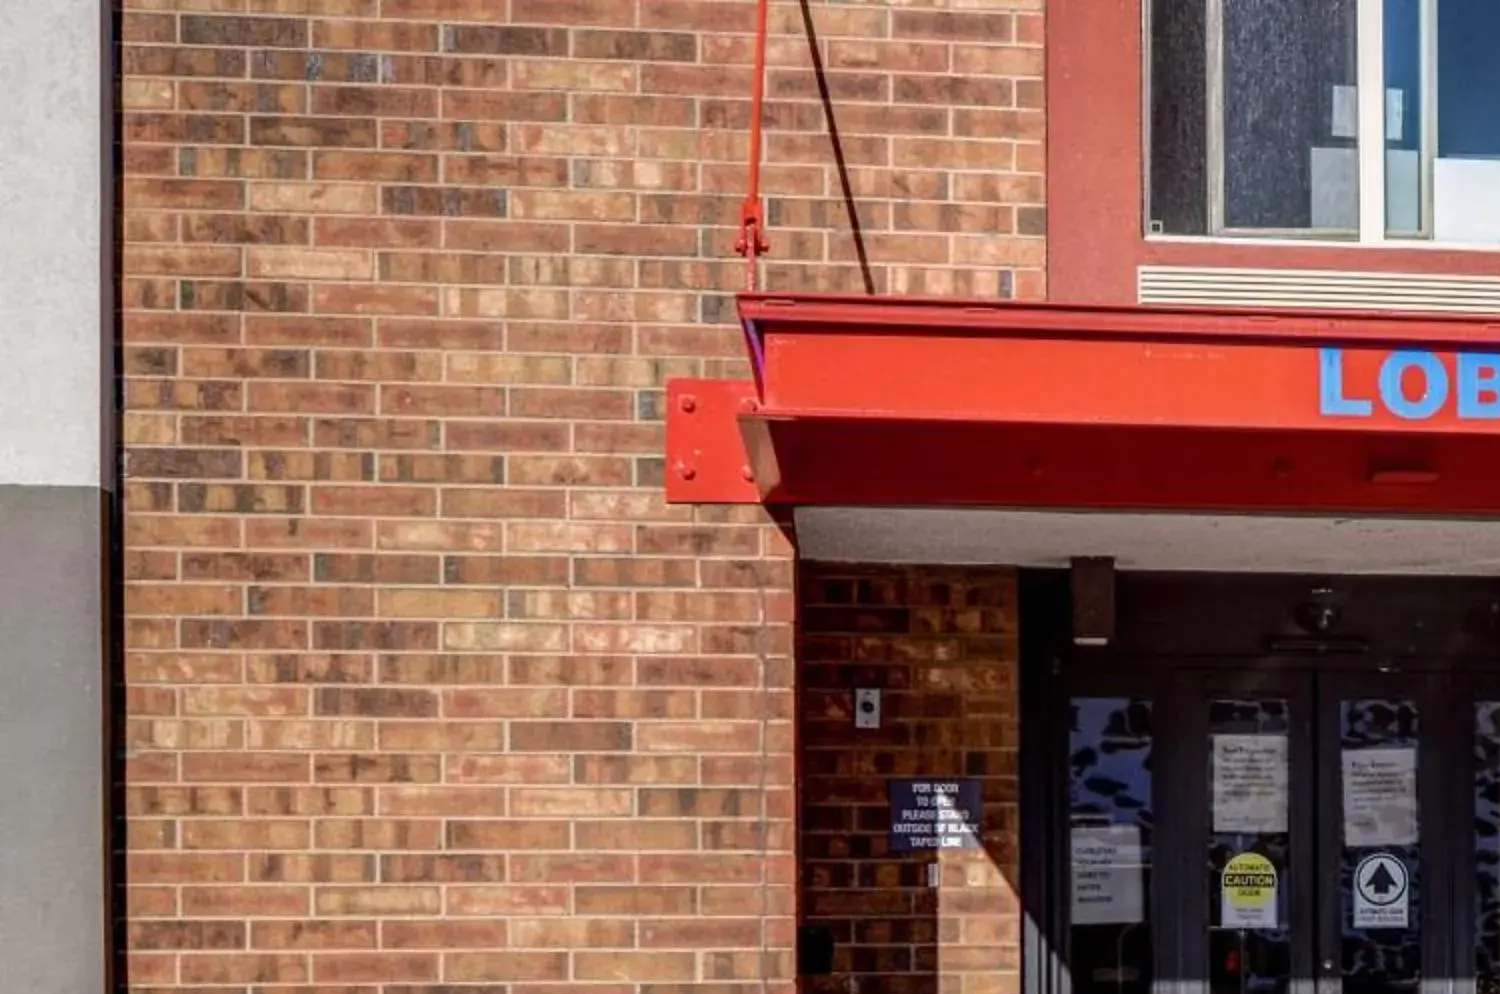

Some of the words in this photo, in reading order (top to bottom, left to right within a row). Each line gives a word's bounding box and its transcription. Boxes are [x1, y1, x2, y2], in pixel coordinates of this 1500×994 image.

[912, 784, 931, 793] FOR
[933, 784, 959, 793] DOOR
[893, 823, 932, 833] OUTSIDE
[948, 823, 979, 833] BLACK
[1226, 876, 1273, 885] CAUTION
